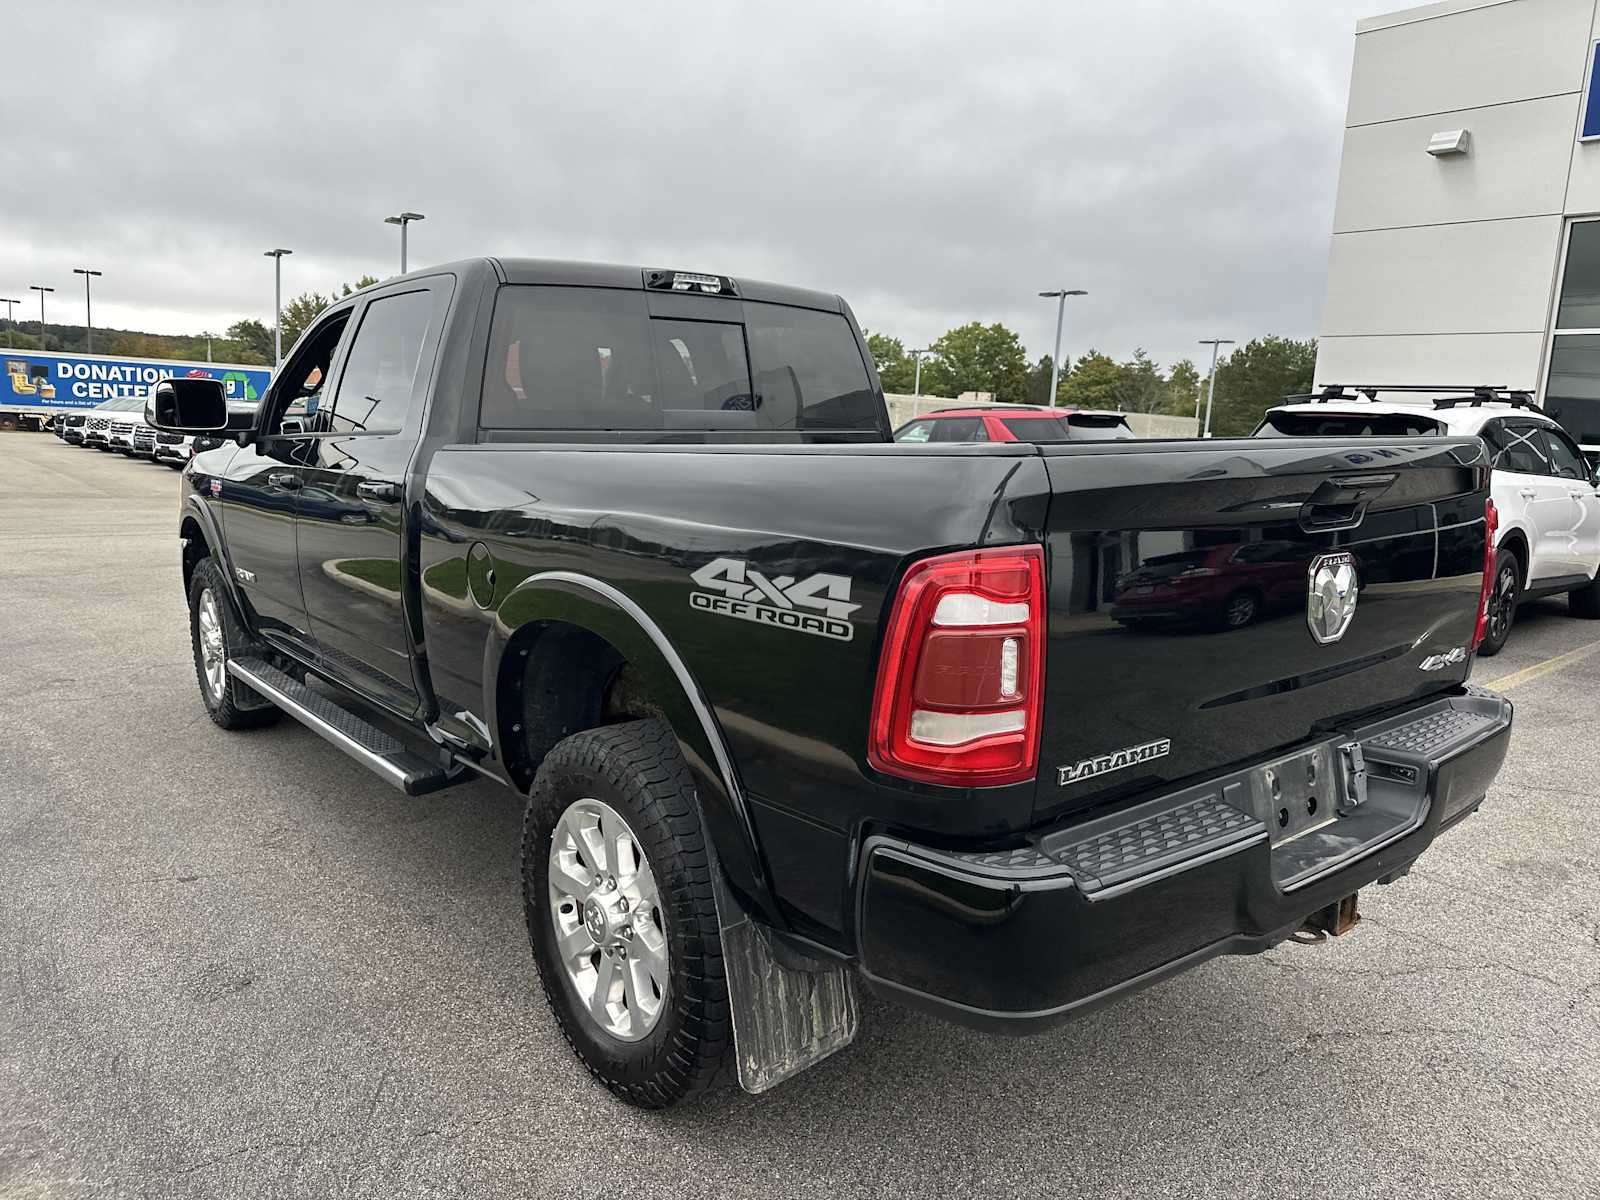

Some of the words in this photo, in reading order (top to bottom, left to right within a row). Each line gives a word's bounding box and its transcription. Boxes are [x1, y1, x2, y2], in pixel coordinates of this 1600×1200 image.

[57, 362, 174, 384] DONATION
[692, 594, 750, 615] OFF
[756, 607, 850, 638] ROAD
[1057, 737, 1171, 786] LARAMIE
